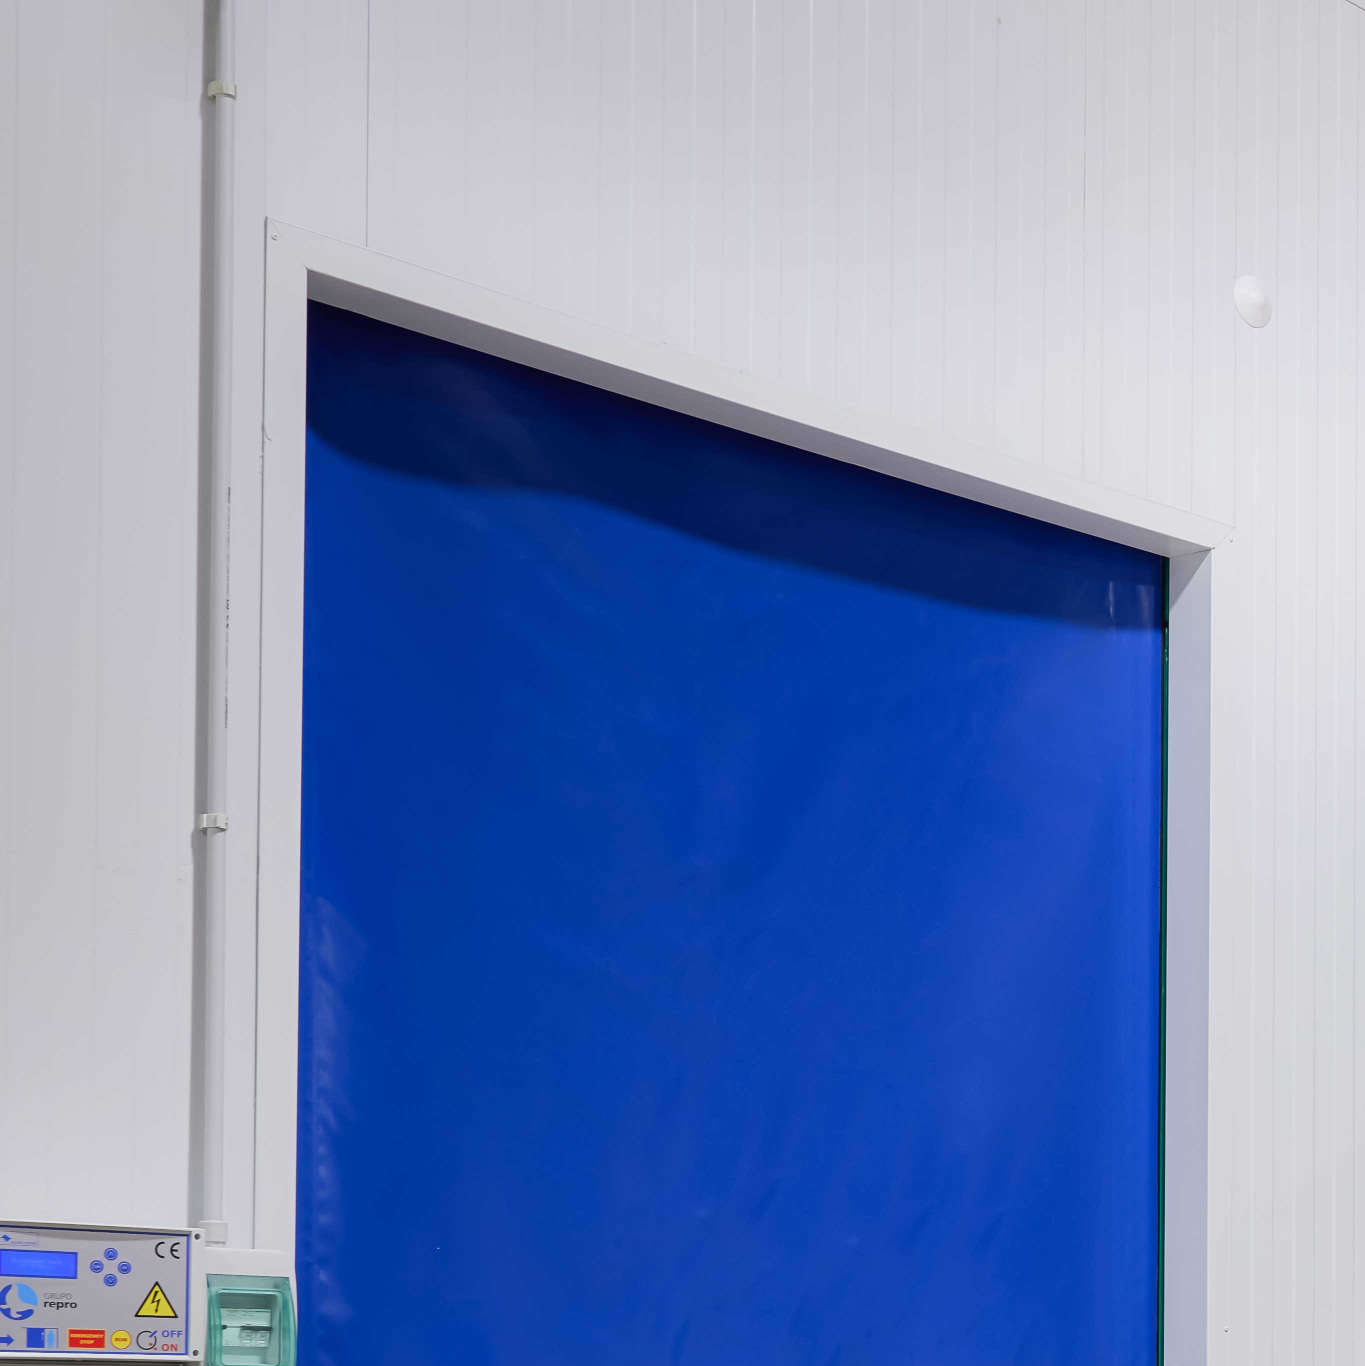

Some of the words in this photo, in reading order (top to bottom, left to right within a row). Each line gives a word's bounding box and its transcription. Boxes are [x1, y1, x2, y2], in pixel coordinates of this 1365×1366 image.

[155, 1241, 181, 1259] CE
[43, 1301, 78, 1310] repro
[161, 1329, 183, 1338] OFF
[161, 1343, 179, 1352] ON
